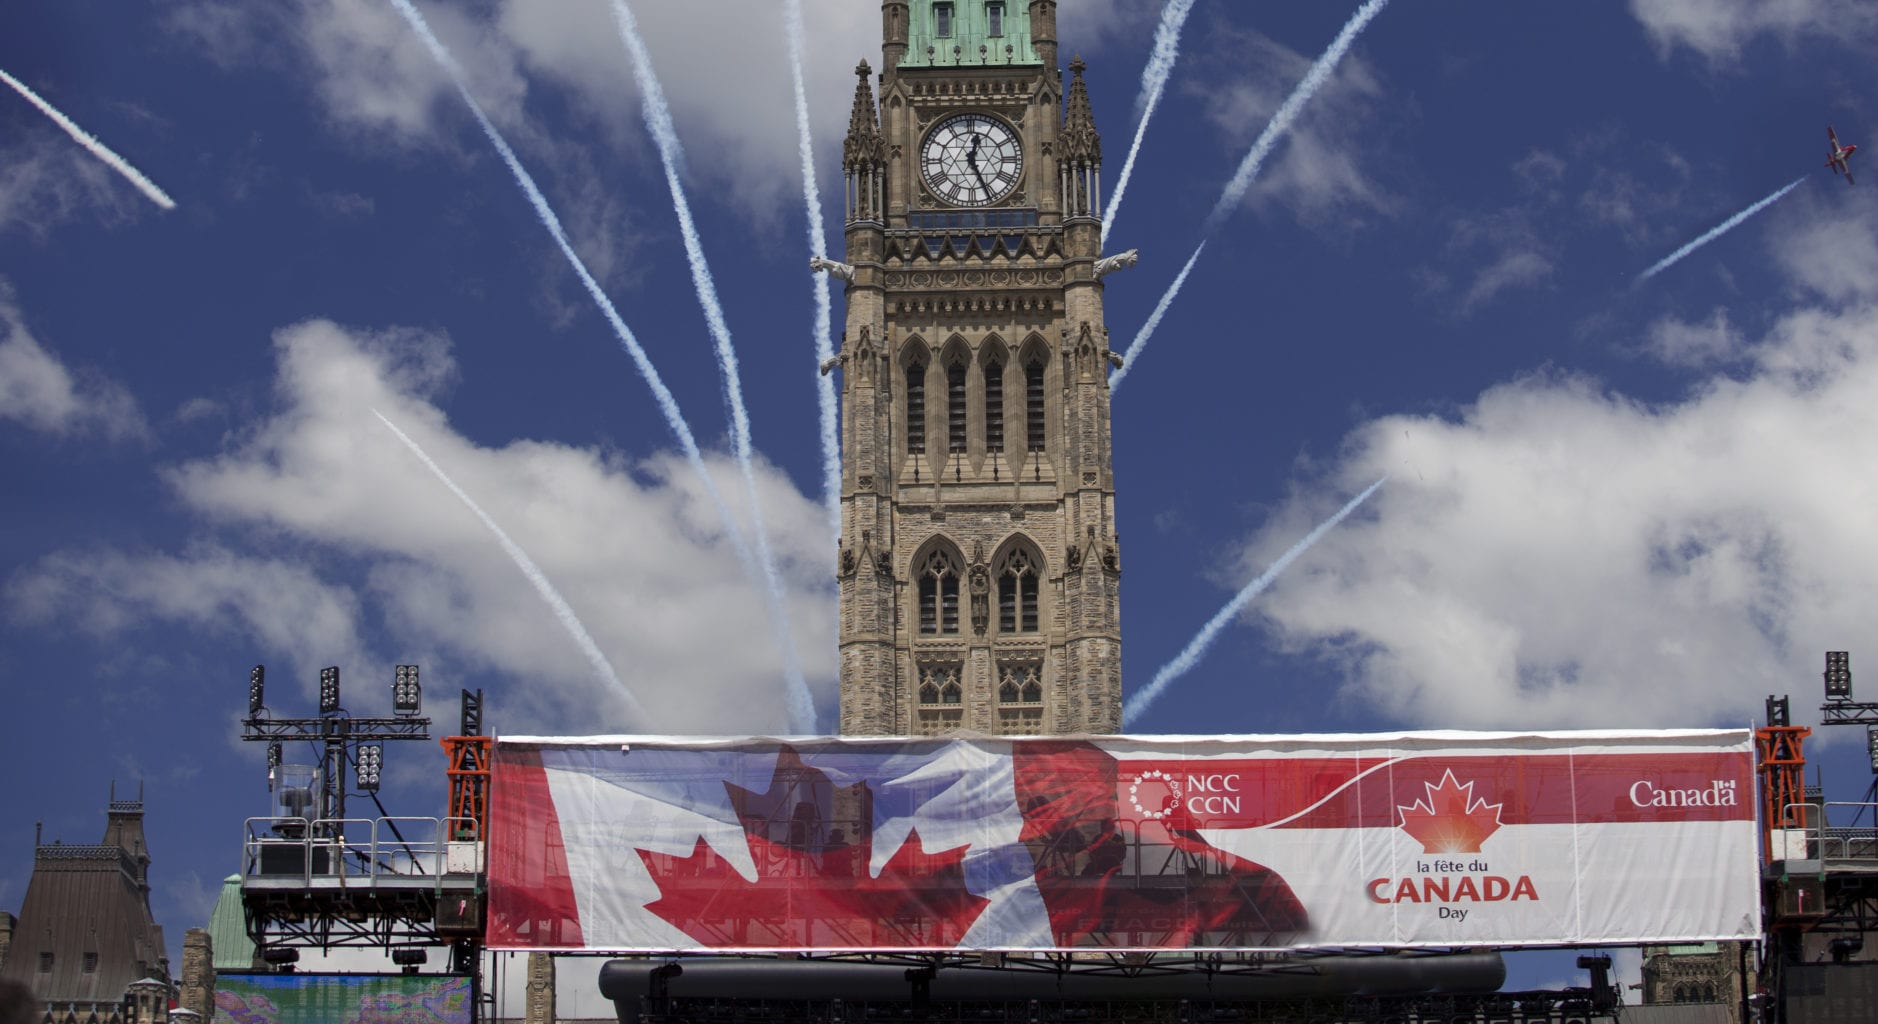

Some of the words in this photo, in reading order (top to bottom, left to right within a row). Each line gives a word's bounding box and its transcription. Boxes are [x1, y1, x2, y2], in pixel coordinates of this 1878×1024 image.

[1187, 774, 1241, 793] NCC
[1629, 779, 1739, 807] Canada
[1187, 796, 1241, 815] CCN
[1417, 860, 1430, 872] la
[1435, 859, 1464, 872] fête
[1468, 859, 1488, 872] du
[1366, 875, 1540, 904] CANADA
[1438, 906, 1469, 922] Day
